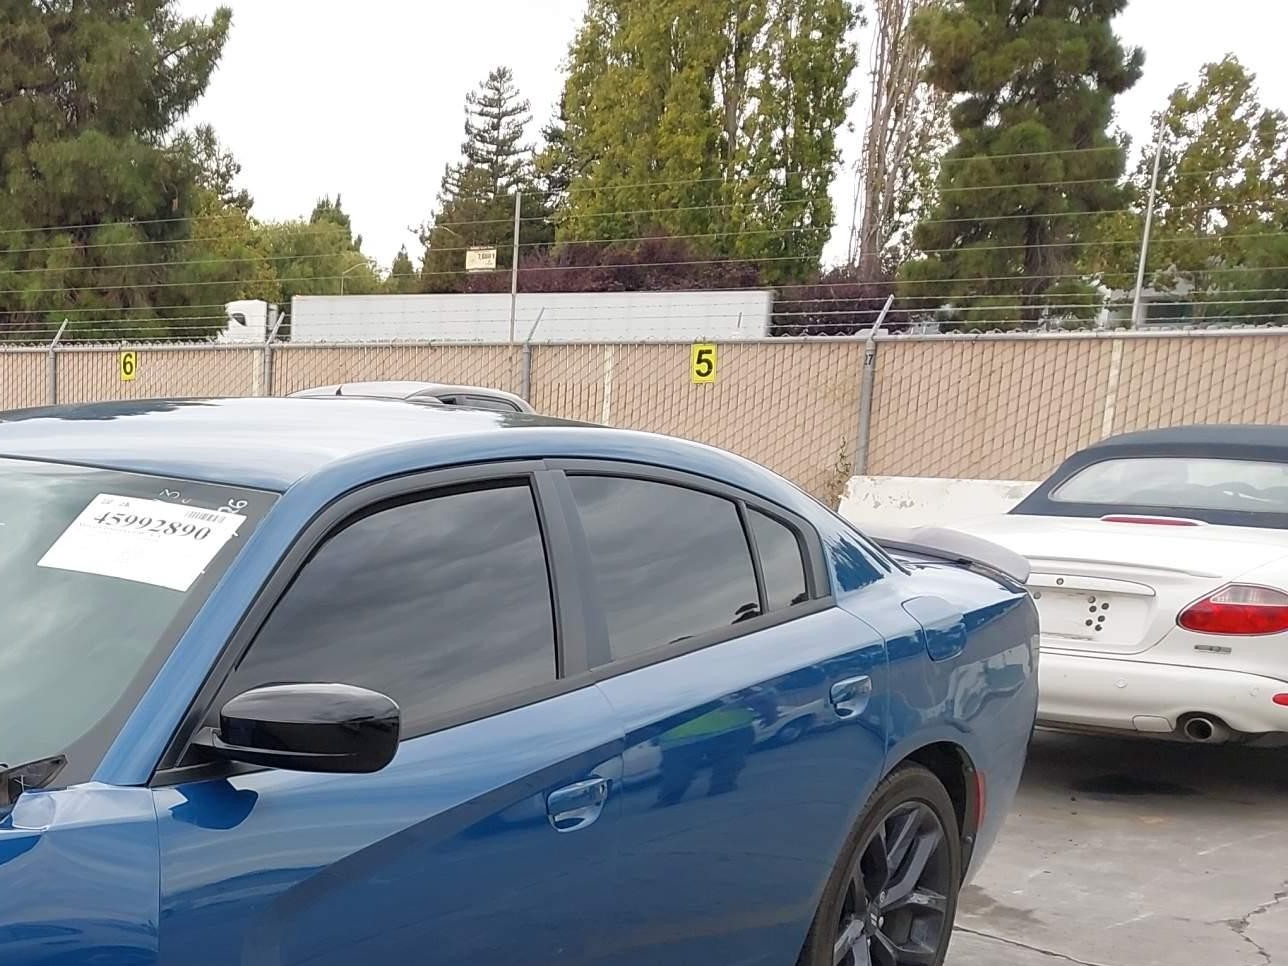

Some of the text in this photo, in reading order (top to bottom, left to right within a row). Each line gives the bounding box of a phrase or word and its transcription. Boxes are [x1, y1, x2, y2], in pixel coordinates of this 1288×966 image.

[122, 353, 133, 375] 6
[695, 349, 713, 377] 5
[94, 511, 212, 541] 45992890
